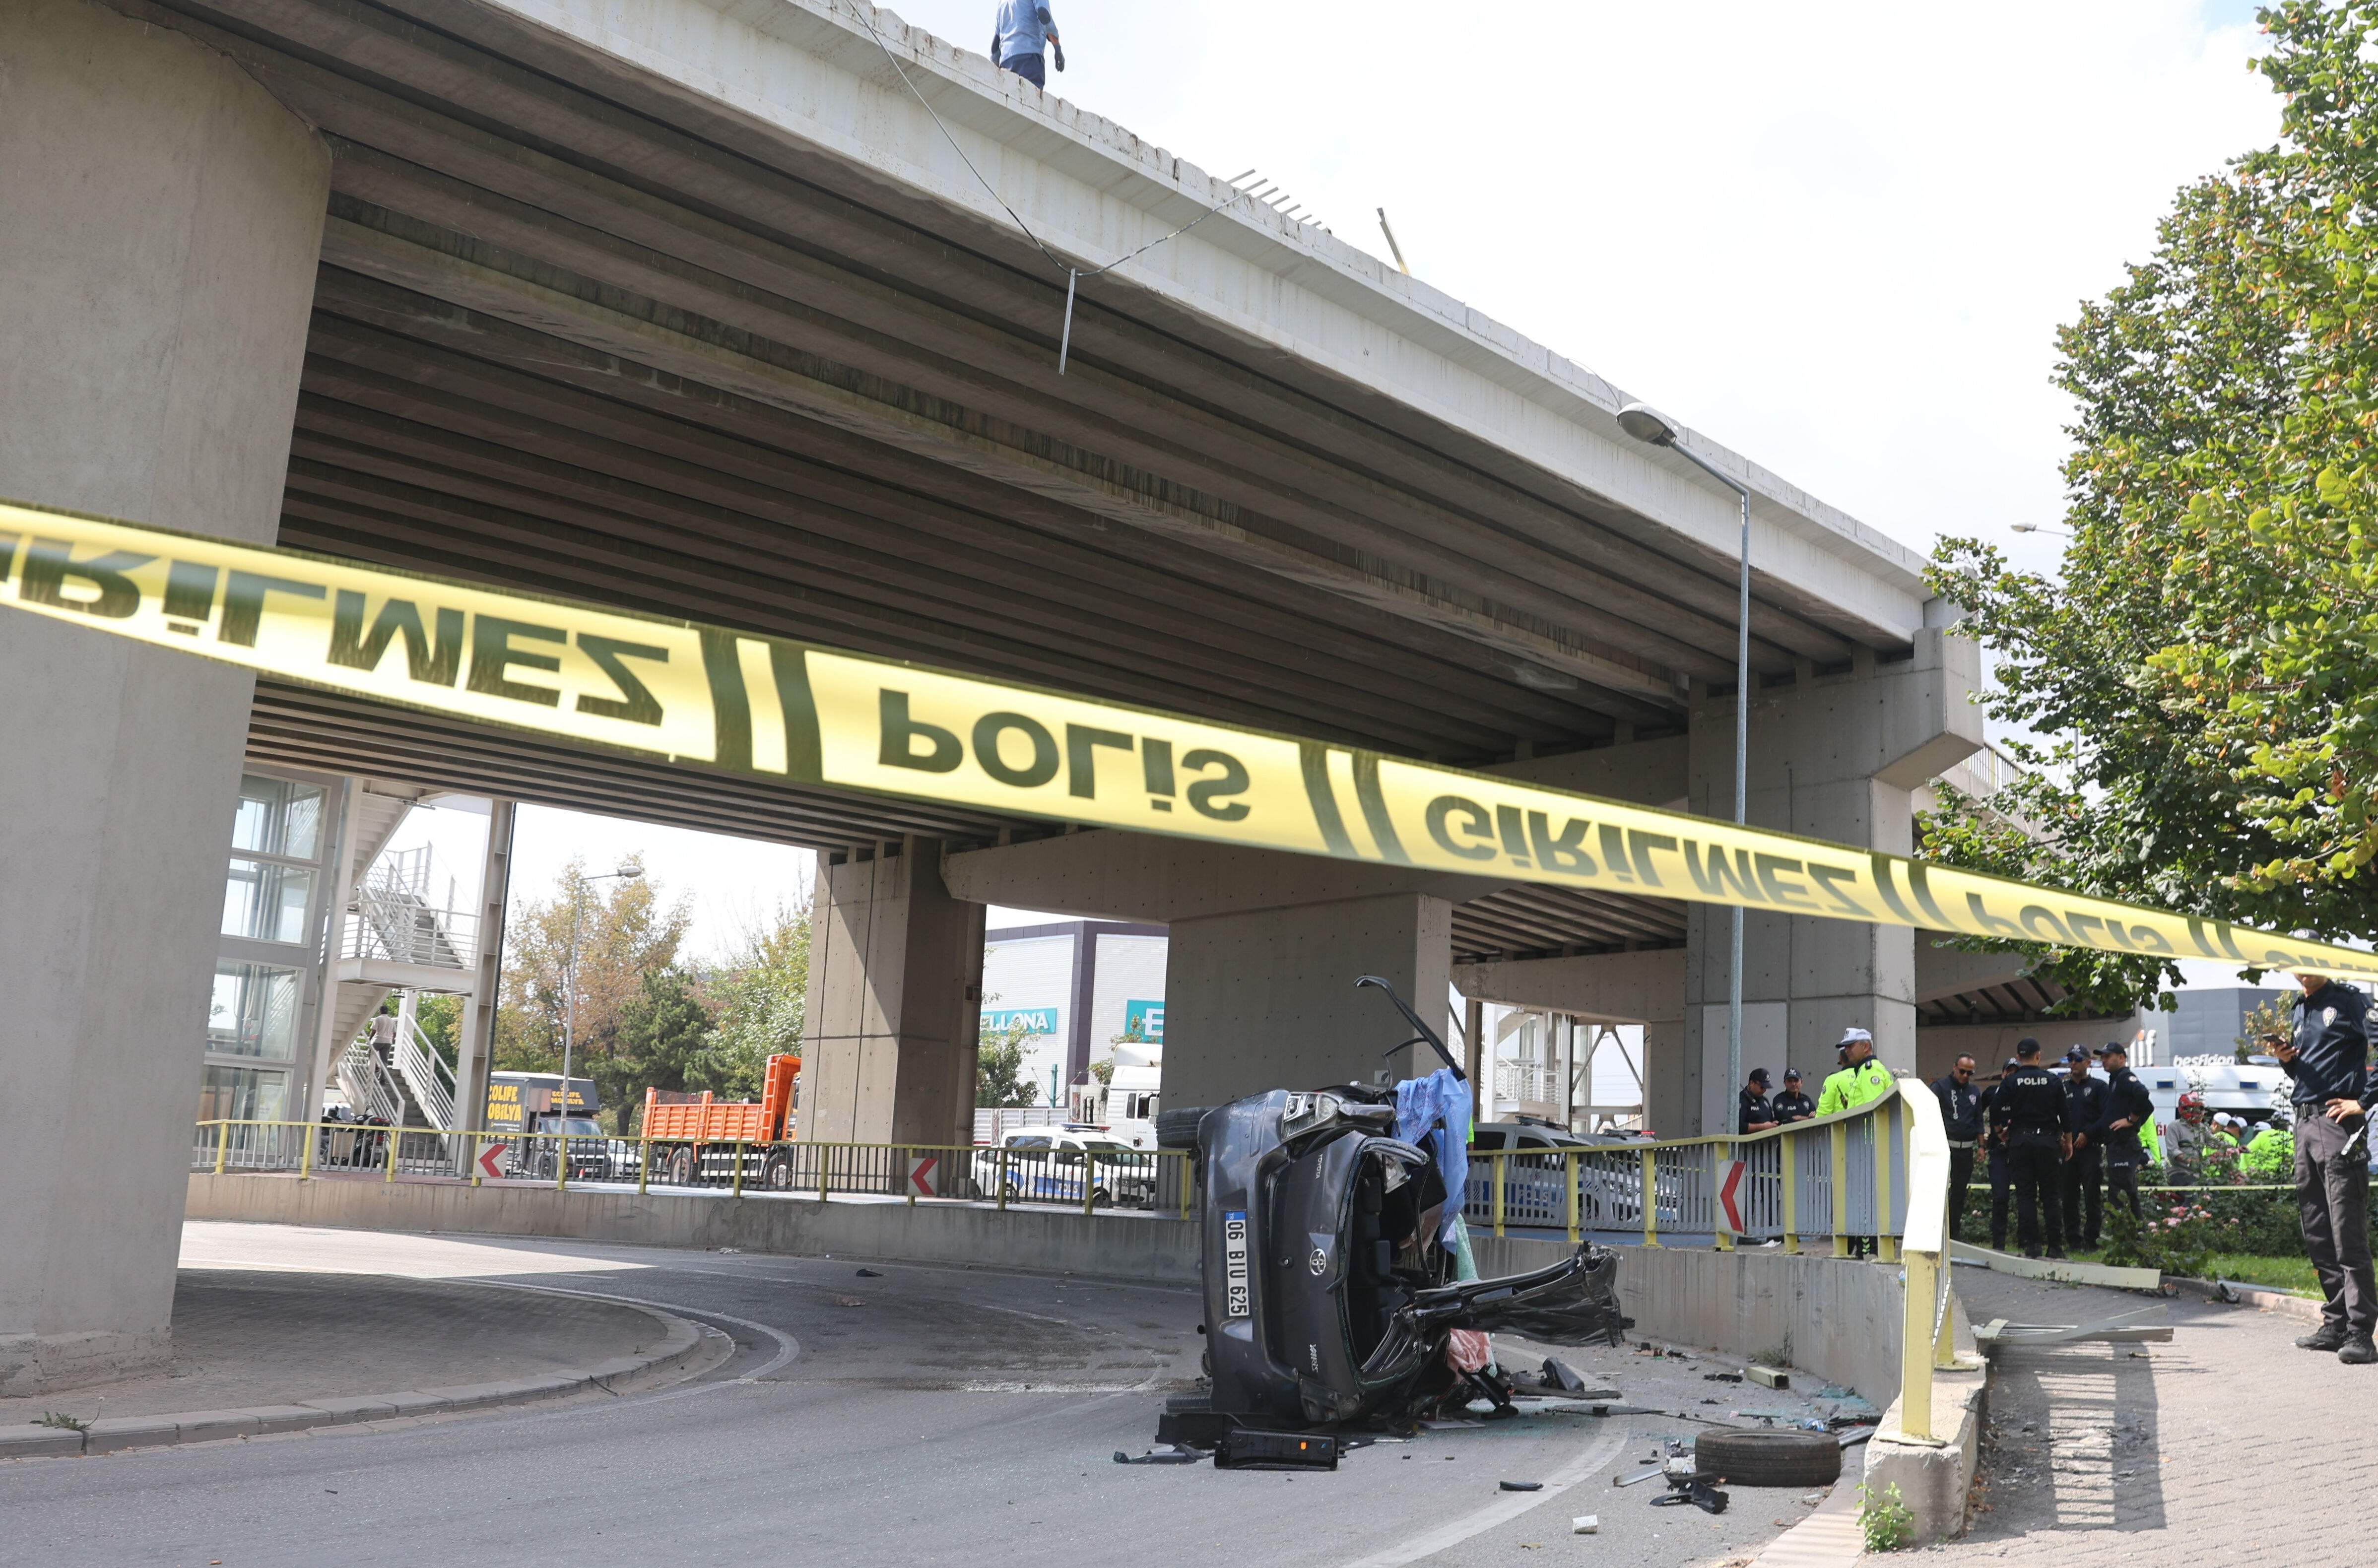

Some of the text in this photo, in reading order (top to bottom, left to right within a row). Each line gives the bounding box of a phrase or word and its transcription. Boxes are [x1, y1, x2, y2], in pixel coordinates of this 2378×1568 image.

[1228, 1222, 1247, 1314] 06 BIU 625
